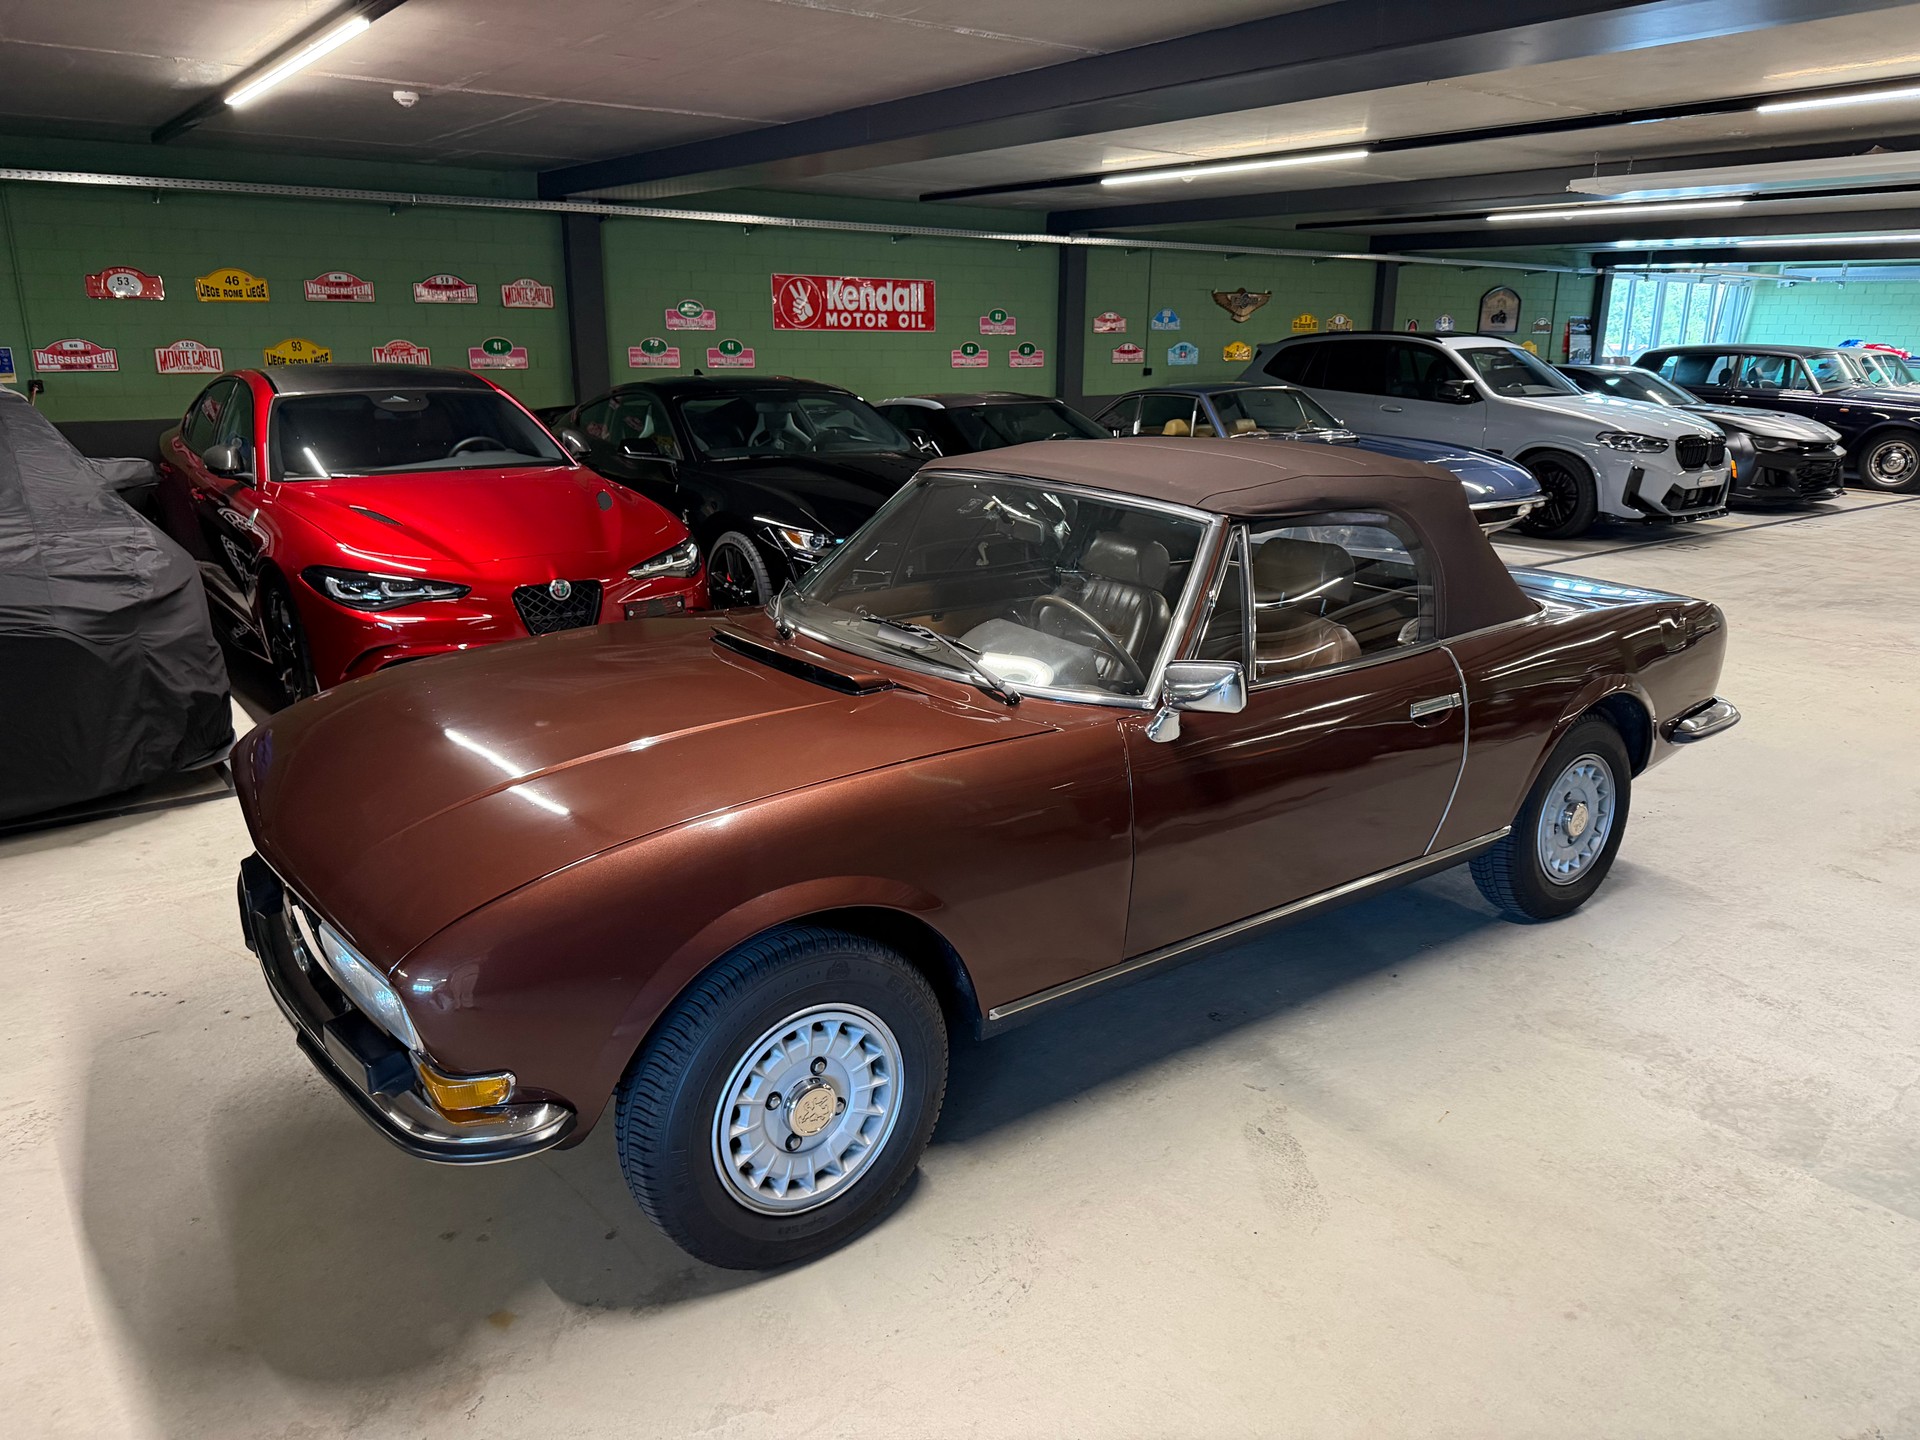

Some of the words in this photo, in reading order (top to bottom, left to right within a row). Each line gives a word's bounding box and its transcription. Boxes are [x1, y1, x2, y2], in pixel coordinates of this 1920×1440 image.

[117, 277, 130, 286] 53
[225, 276, 239, 286] 46
[306, 281, 372, 295] WEISSENSTEIN
[199, 282, 220, 297] LIEGE
[223, 289, 243, 297] ROME
[246, 283, 266, 297] LIEGE
[826, 280, 926, 312] Kendall
[826, 312, 888, 328] MOTOR
[898, 314, 926, 328] OIL
[292, 341, 302, 352] 93
[493, 342, 502, 350] 41
[36, 350, 114, 364] WEISSENSTEIN
[158, 350, 190, 371] MONTE
[191, 350, 221, 371] CARLO
